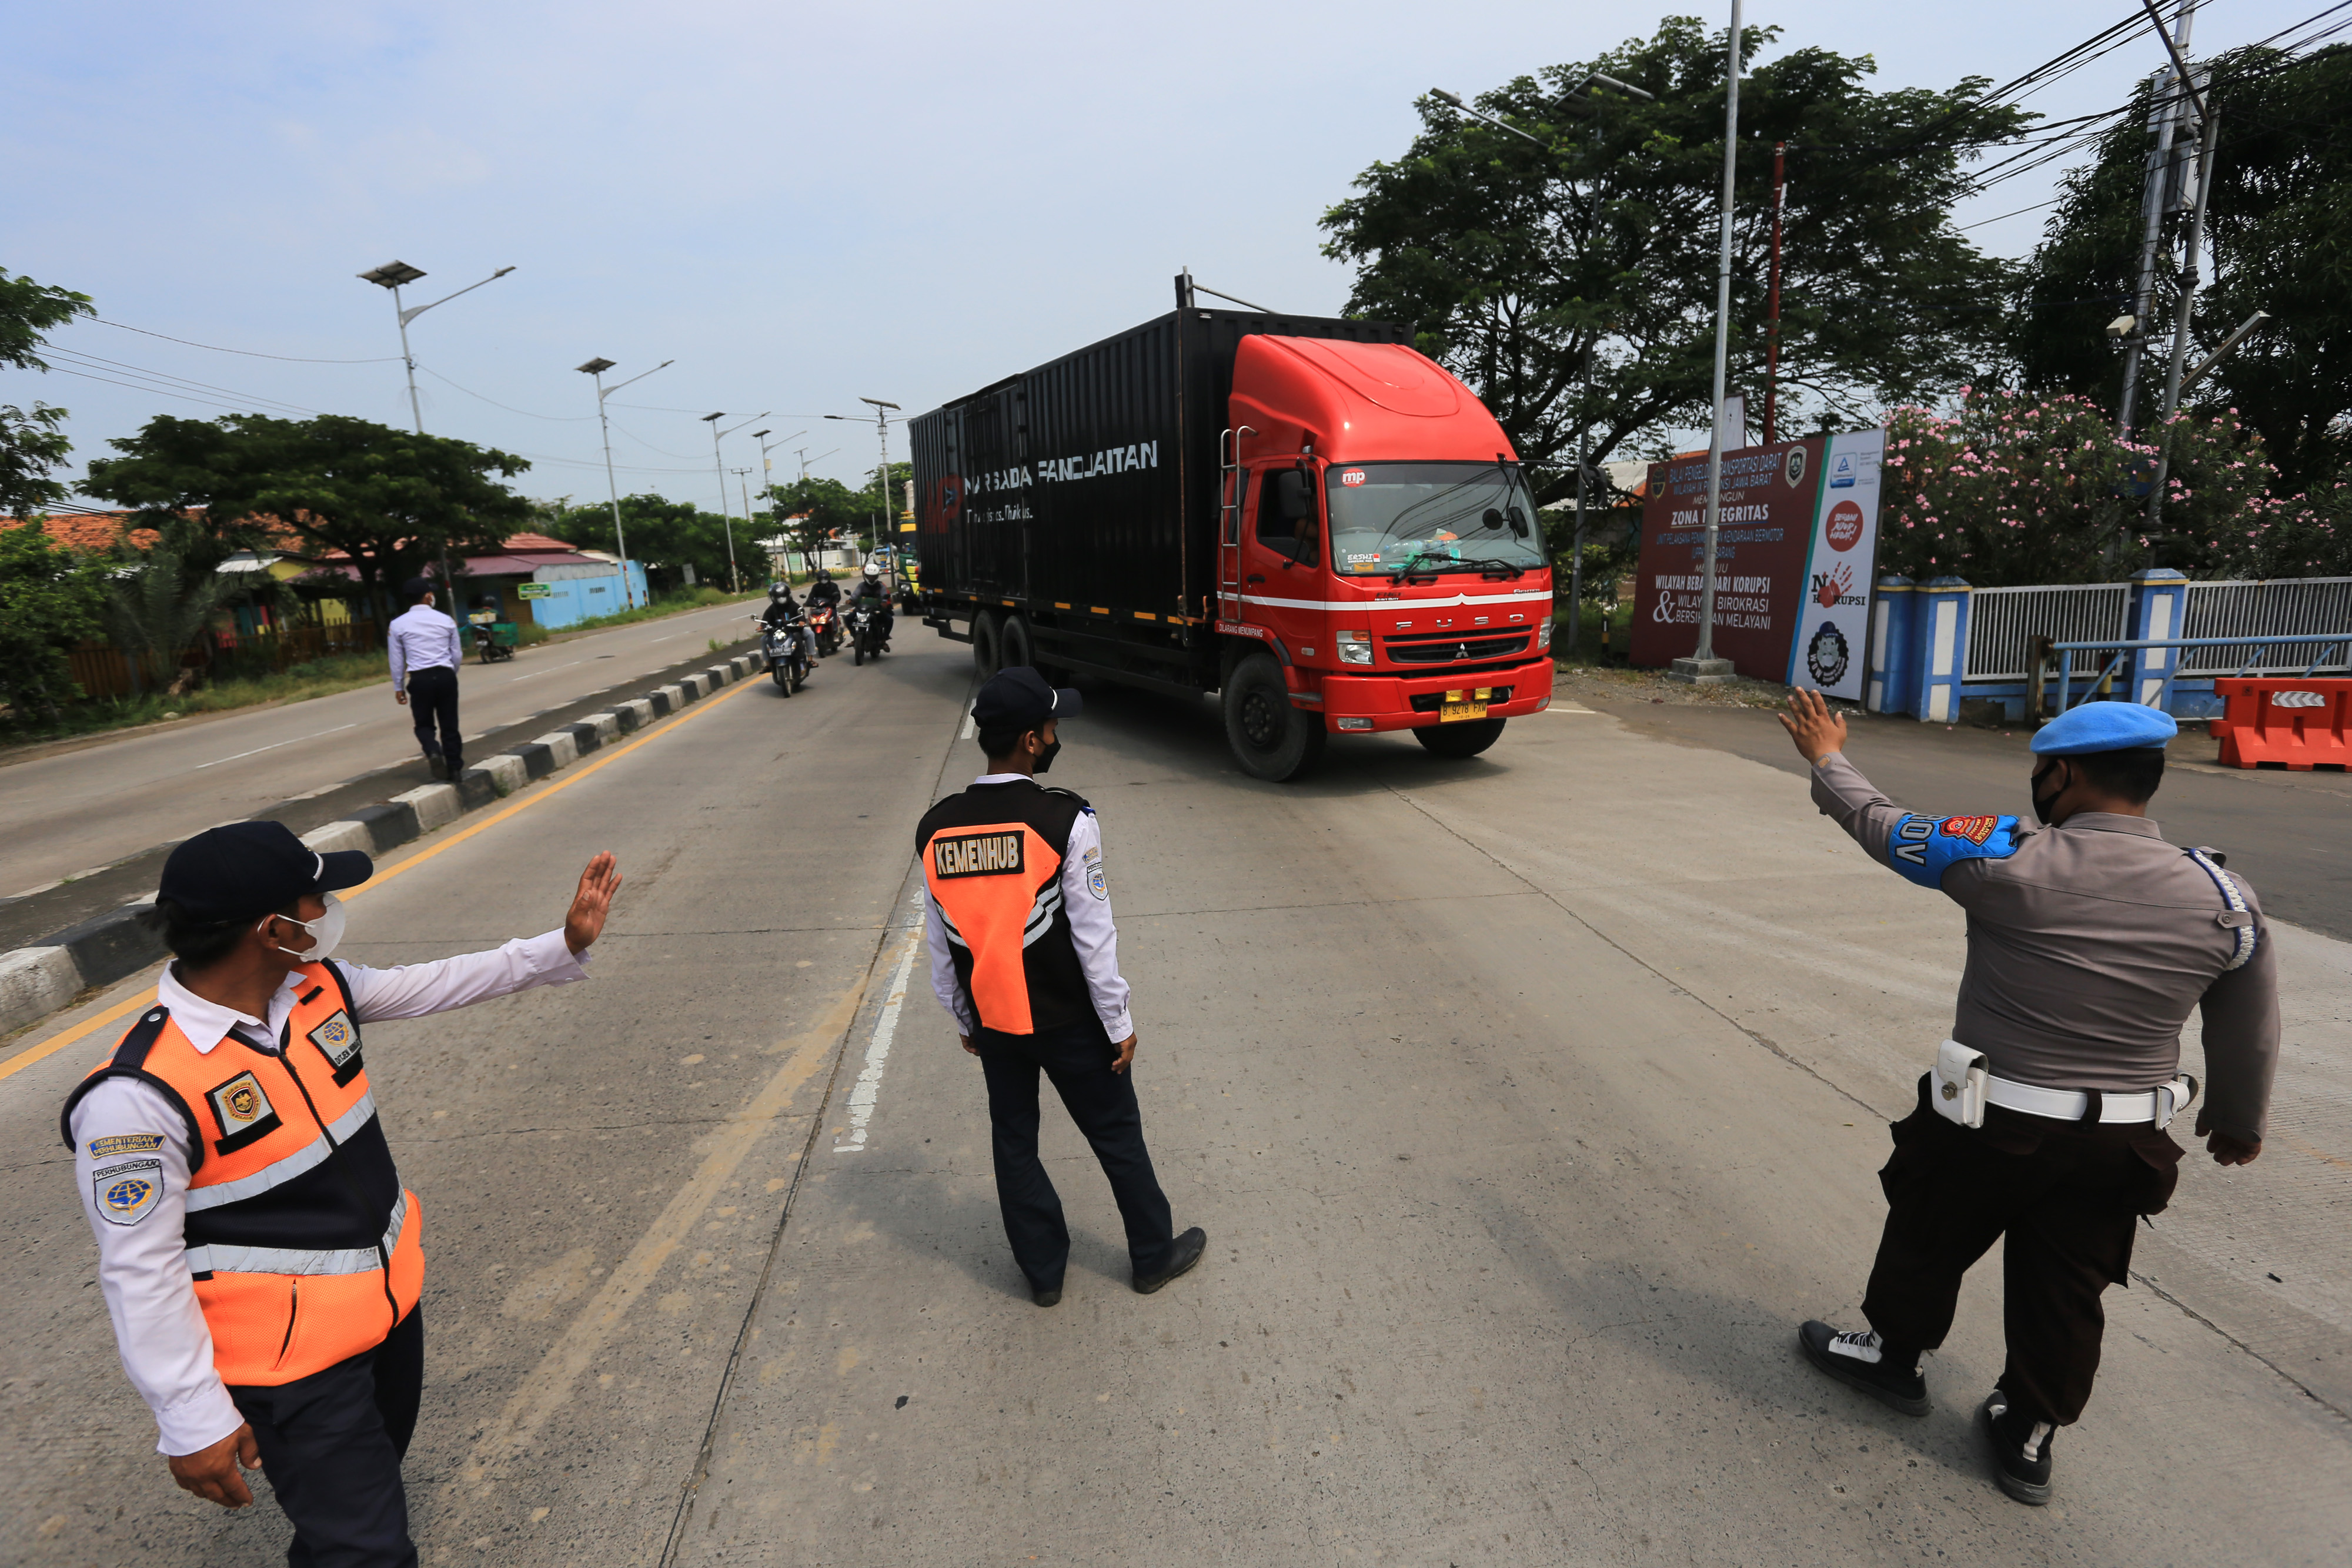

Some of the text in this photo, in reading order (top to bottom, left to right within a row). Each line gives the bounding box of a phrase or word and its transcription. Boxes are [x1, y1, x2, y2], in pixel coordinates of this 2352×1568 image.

[1720, 456, 1759, 476] RANSPORTASI
[1760, 452, 1782, 471] DARAT
[1731, 477, 1749, 489] JAWA
[1750, 473, 1773, 487] BARAT
[1671, 504, 1769, 526] ZONA ITEGRITAS
[1656, 575, 1686, 590] WILAYAH
[1687, 576, 1704, 591] BEBA
[1733, 576, 1770, 593] KORUPSI
[1653, 590, 1769, 623] & WILAY BIROKRASI
[1219, 623, 1263, 637] DILARANG MENUMPANG
[1396, 614, 1524, 630] FUSO
[1726, 613, 1771, 630] MELAYANI
[1452, 703, 1469, 715] 9278
[935, 835, 1019, 875] KEMENHUB
[93, 1142, 157, 1156] PERHUBUNGAN
[95, 1135, 155, 1148] KEMENTERIAN
[96, 1160, 157, 1178] PERHUBUNGAN
